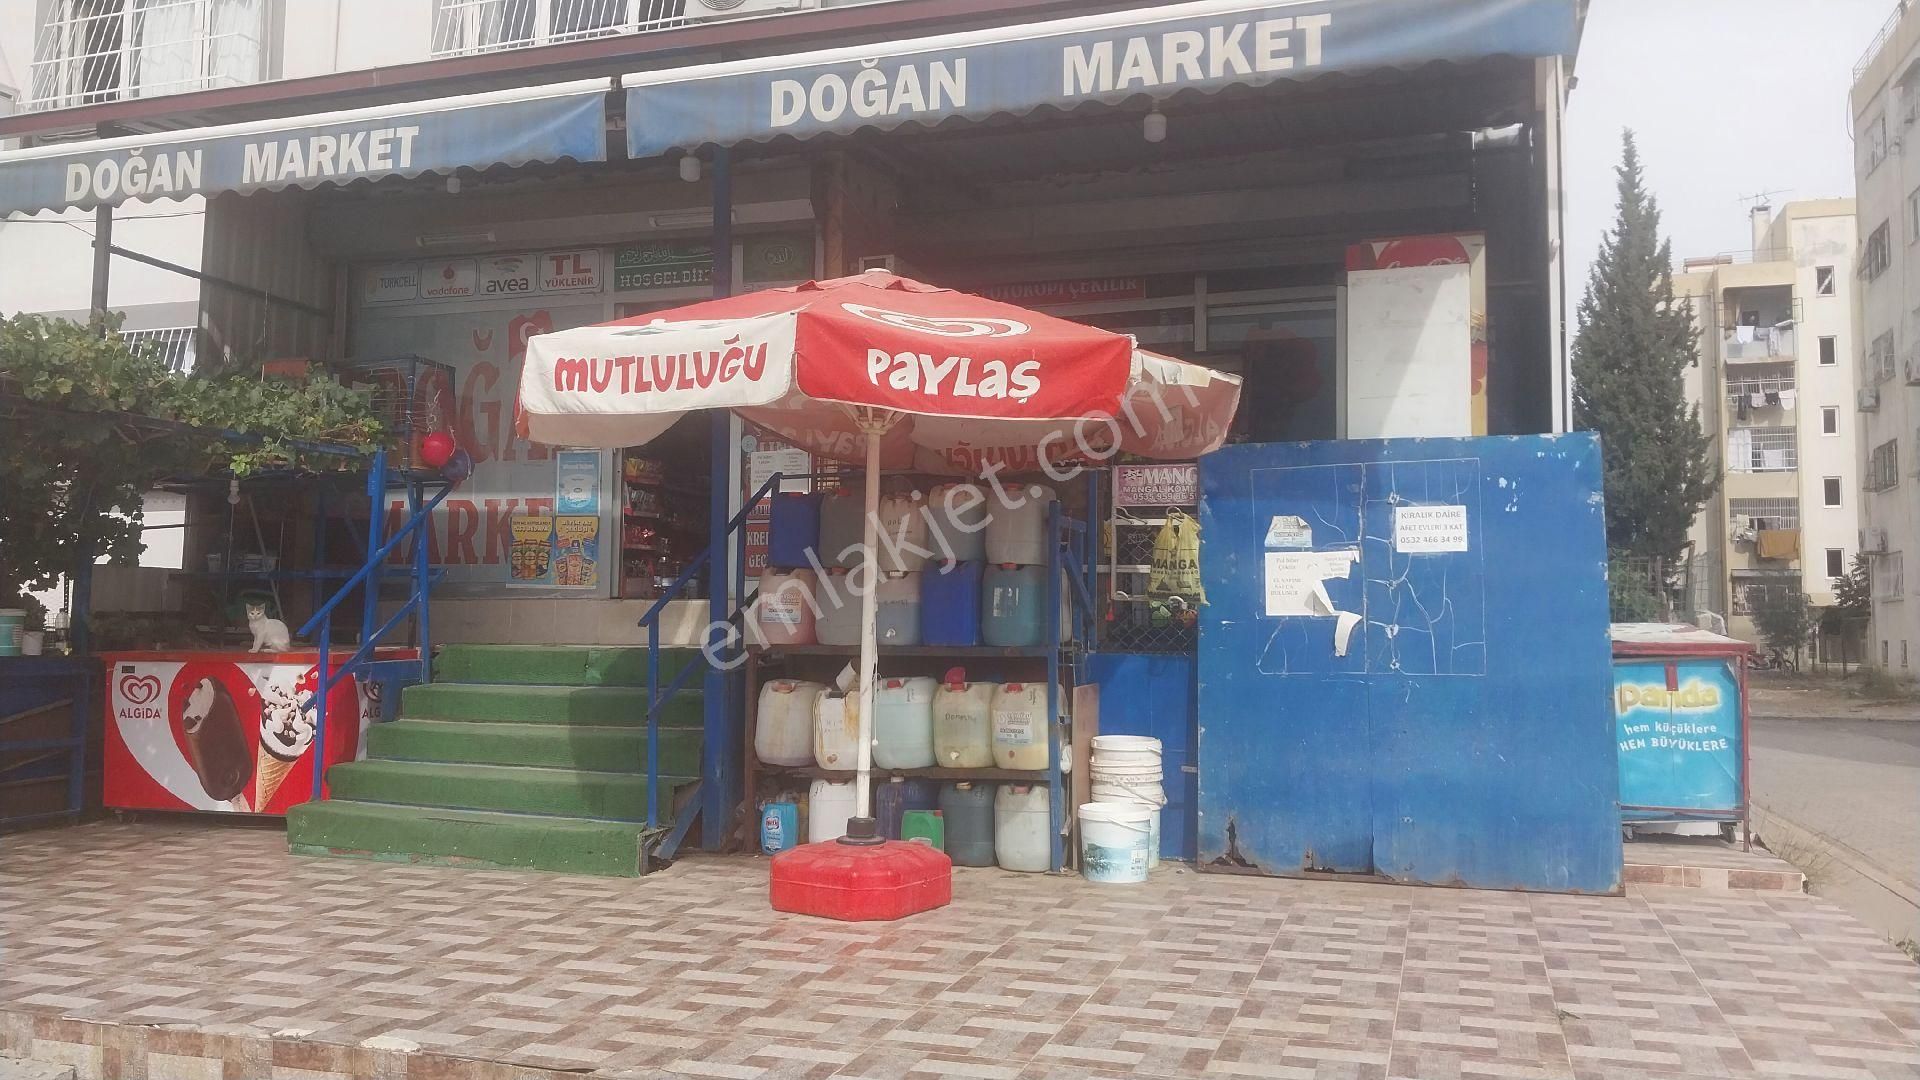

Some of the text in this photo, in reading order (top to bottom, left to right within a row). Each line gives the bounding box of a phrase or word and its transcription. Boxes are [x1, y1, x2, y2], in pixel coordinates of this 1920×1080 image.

[770, 13, 1332, 128] DOĞAN MARKET
[65, 125, 420, 202] DOĞAN MARKET
[549, 254, 592, 276] TL
[427, 286, 470, 297] vodafone
[486, 277, 530, 293] avea
[553, 334, 768, 393] MUTLULUĞU
[1143, 467, 1198, 485] MANG
[1152, 558, 1199, 570] MANGA
[1617, 680, 1719, 714] panda
[361, 710, 381, 719] ALG
[1624, 721, 1717, 736] hem küçüklere
[1619, 736, 1729, 752] HEM BÜYÜKLERE
